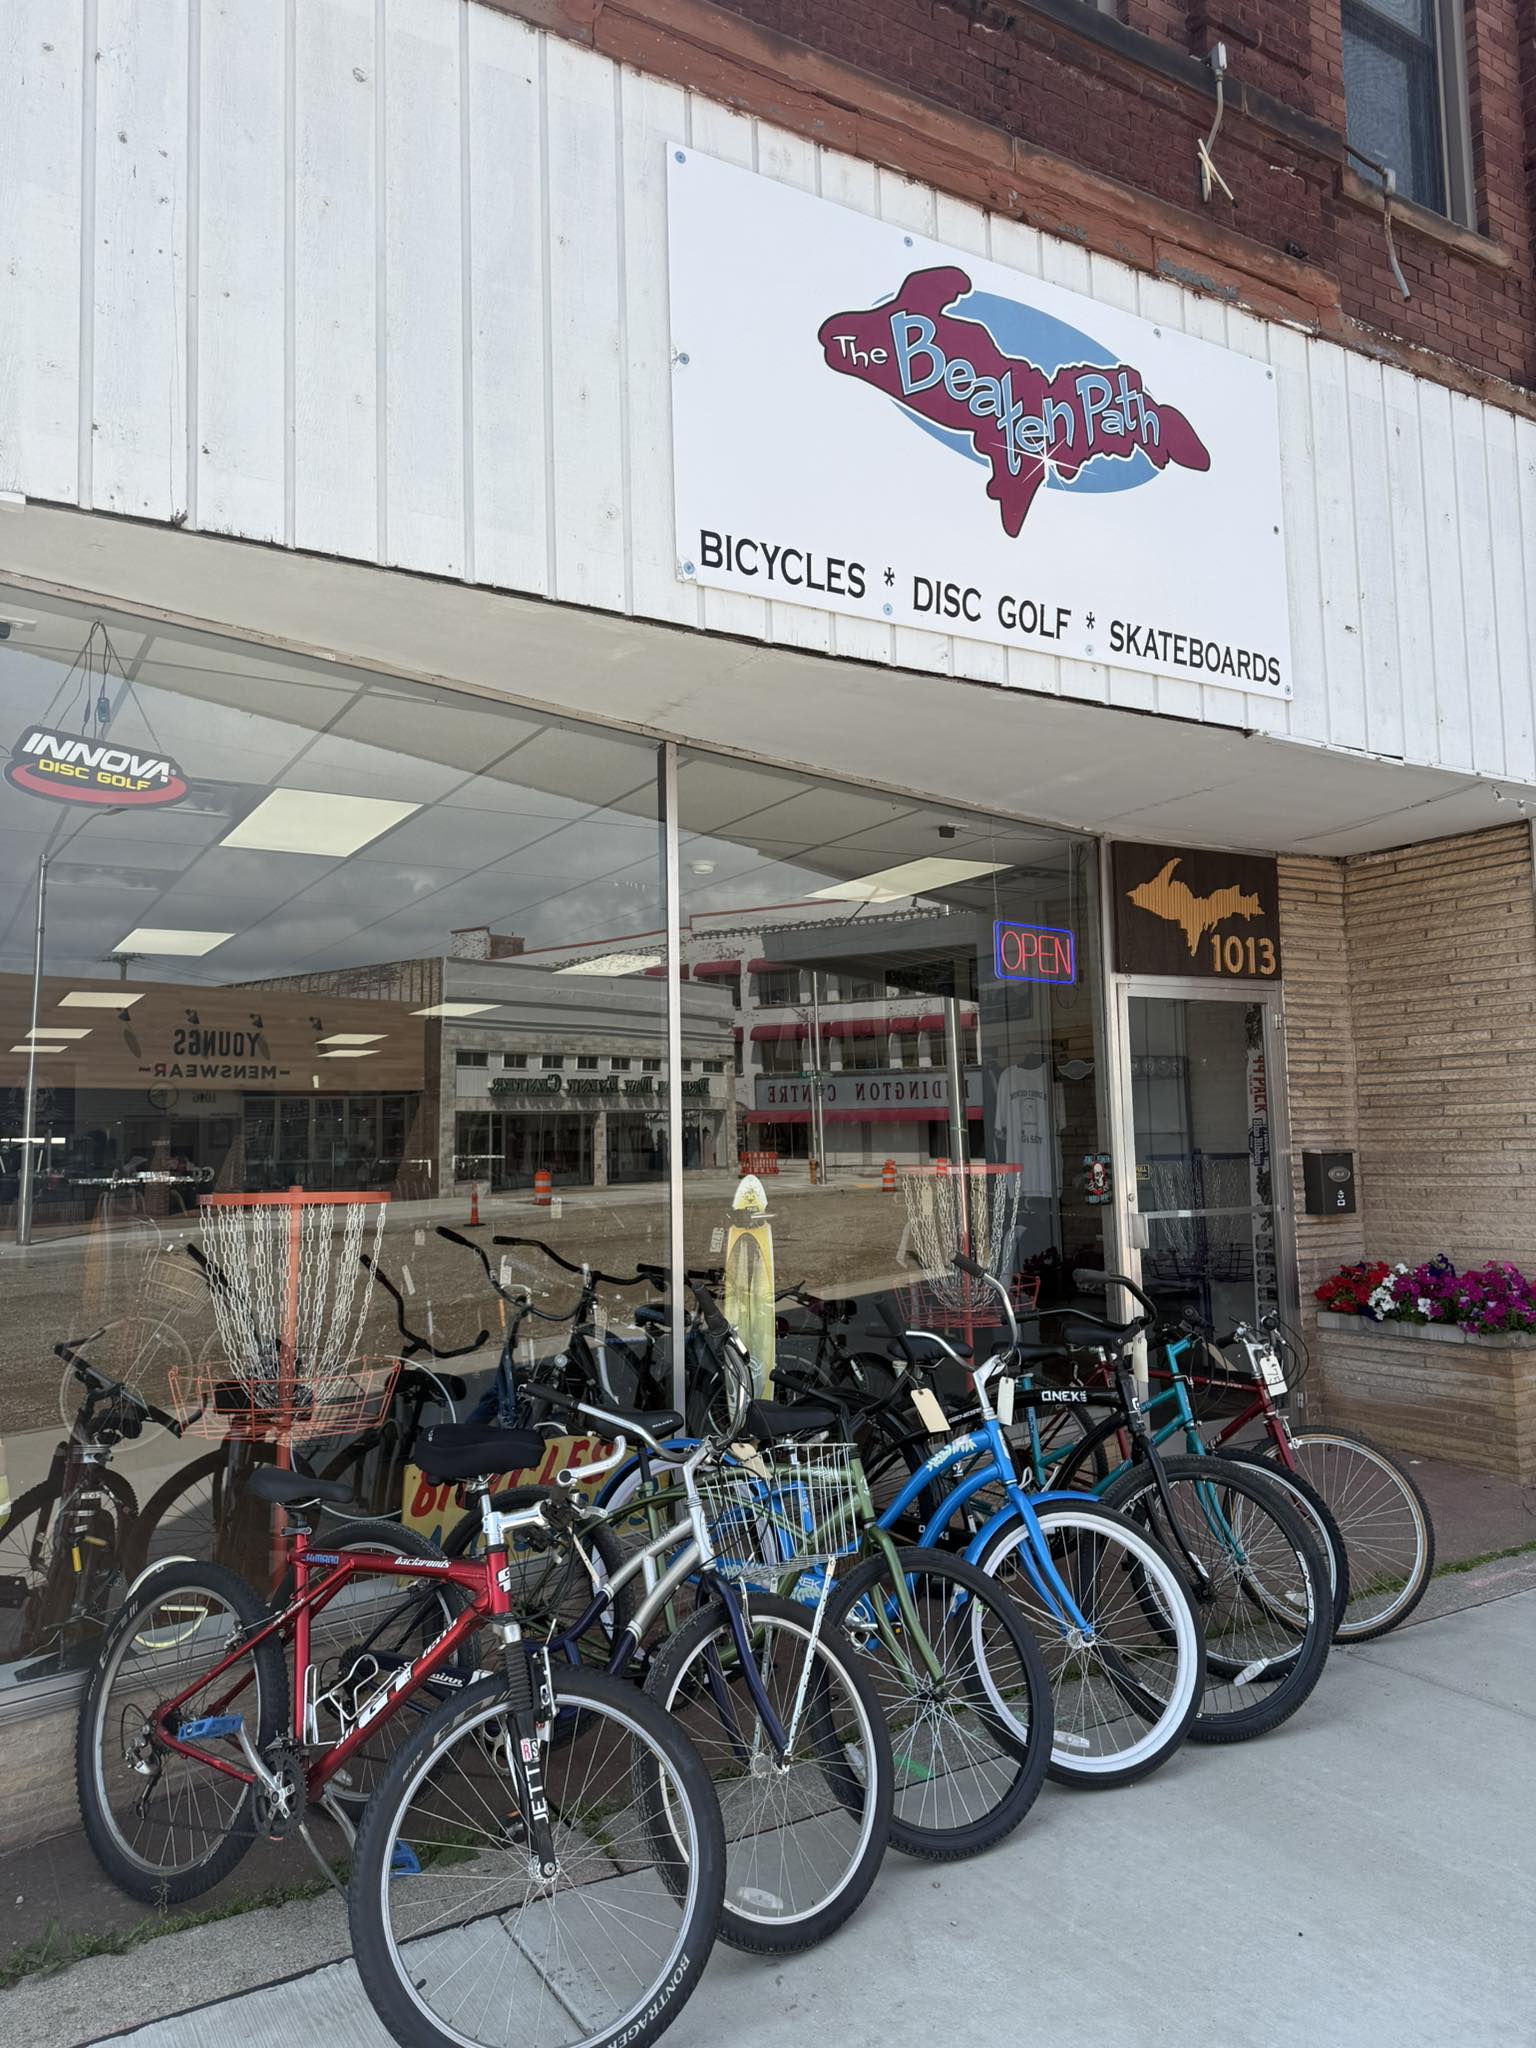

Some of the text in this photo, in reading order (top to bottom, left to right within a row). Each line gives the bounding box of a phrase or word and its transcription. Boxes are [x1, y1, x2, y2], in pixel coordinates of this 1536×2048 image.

[832, 310, 1162, 476] The Beaten Path
[699, 529, 1282, 687] BICYCLES DISC GOLF SKATEBOARDS
[22, 732, 170, 783] INNOVA
[38, 758, 152, 791] DISC GOLF
[1001, 930, 1072, 976] OPEN
[1211, 933, 1277, 975] 1013
[1254, 1077, 1268, 1114] PACK
[394, 1556, 452, 1569] backwoods
[497, 1566, 512, 1593] GT
[524, 1765, 550, 1824] JETT
